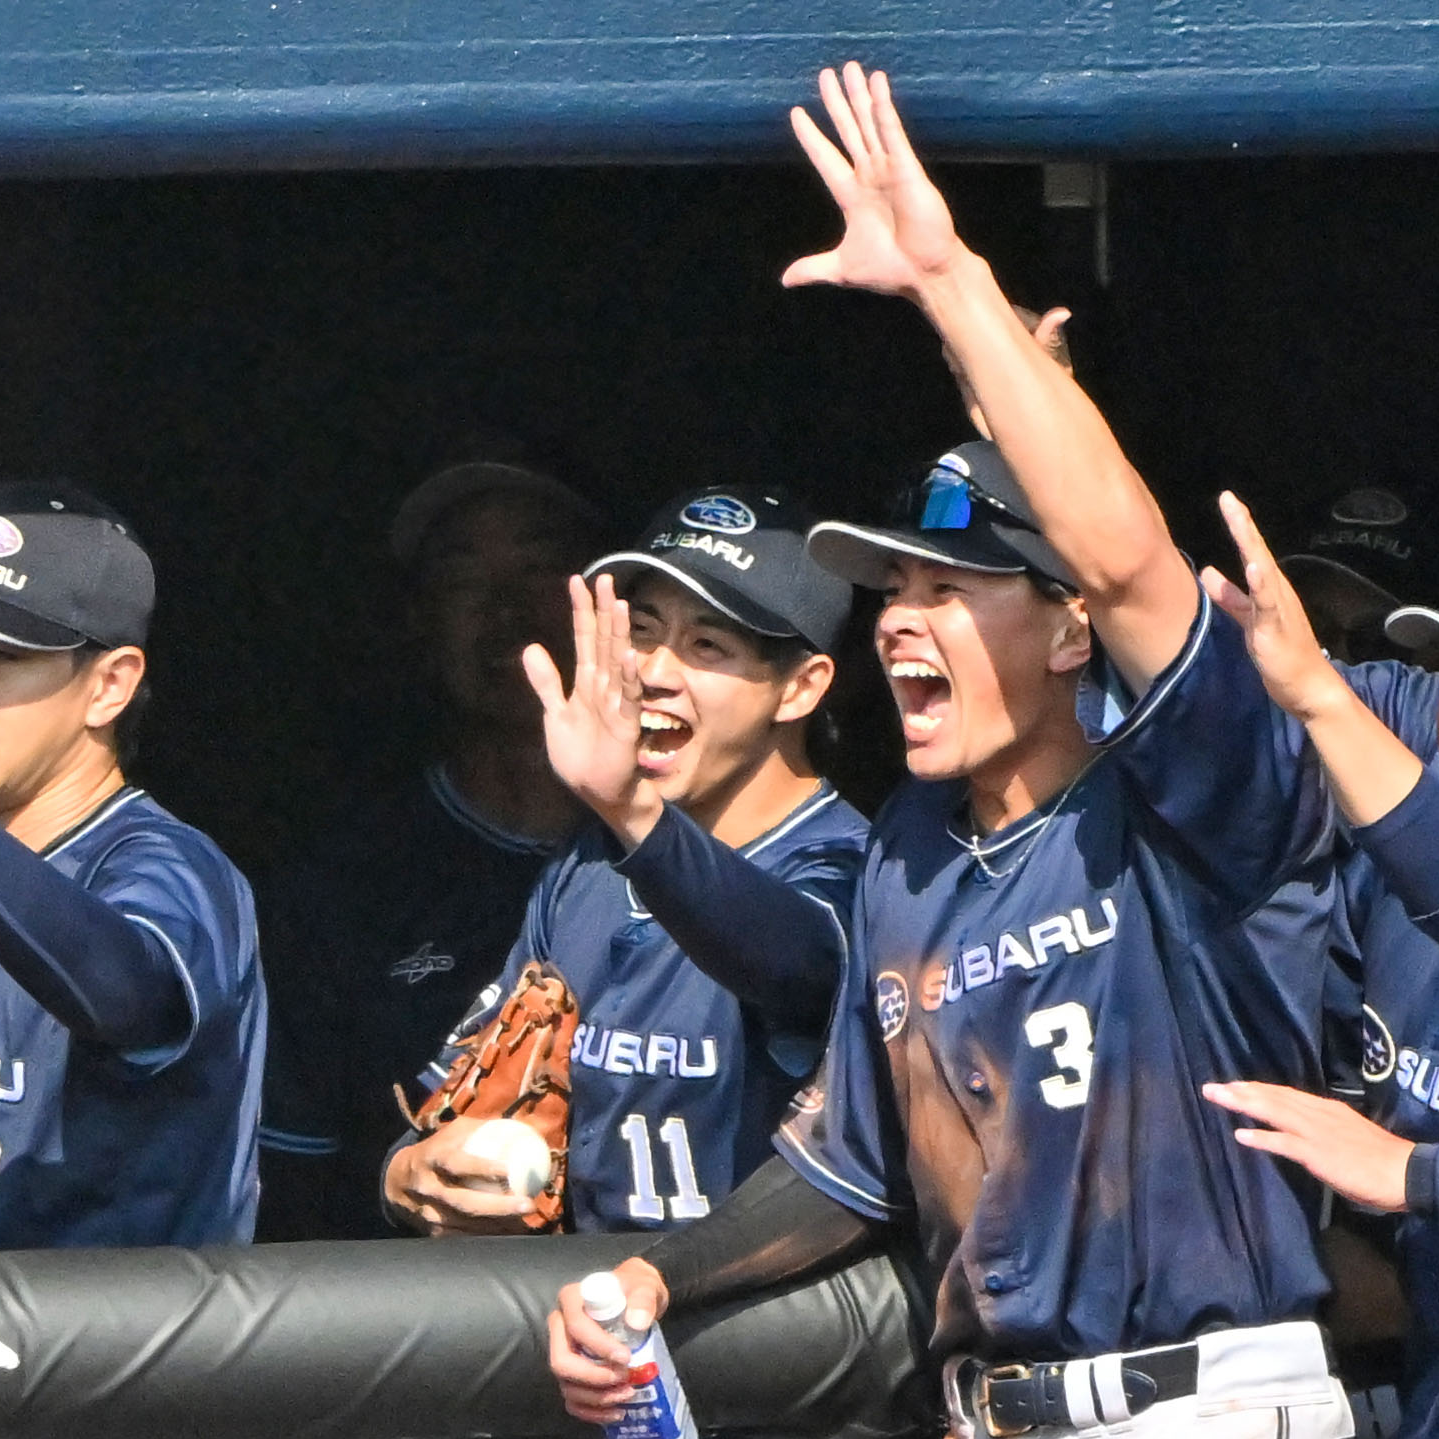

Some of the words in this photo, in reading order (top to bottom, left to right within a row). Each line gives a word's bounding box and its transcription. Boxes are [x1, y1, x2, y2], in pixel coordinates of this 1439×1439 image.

[651, 531, 755, 571] SUBARU
[920, 897, 1119, 1011] SUBARU
[571, 1023, 718, 1078] SUBARU
[1025, 1001, 1095, 1108] 3
[620, 1114, 710, 1222] 11
